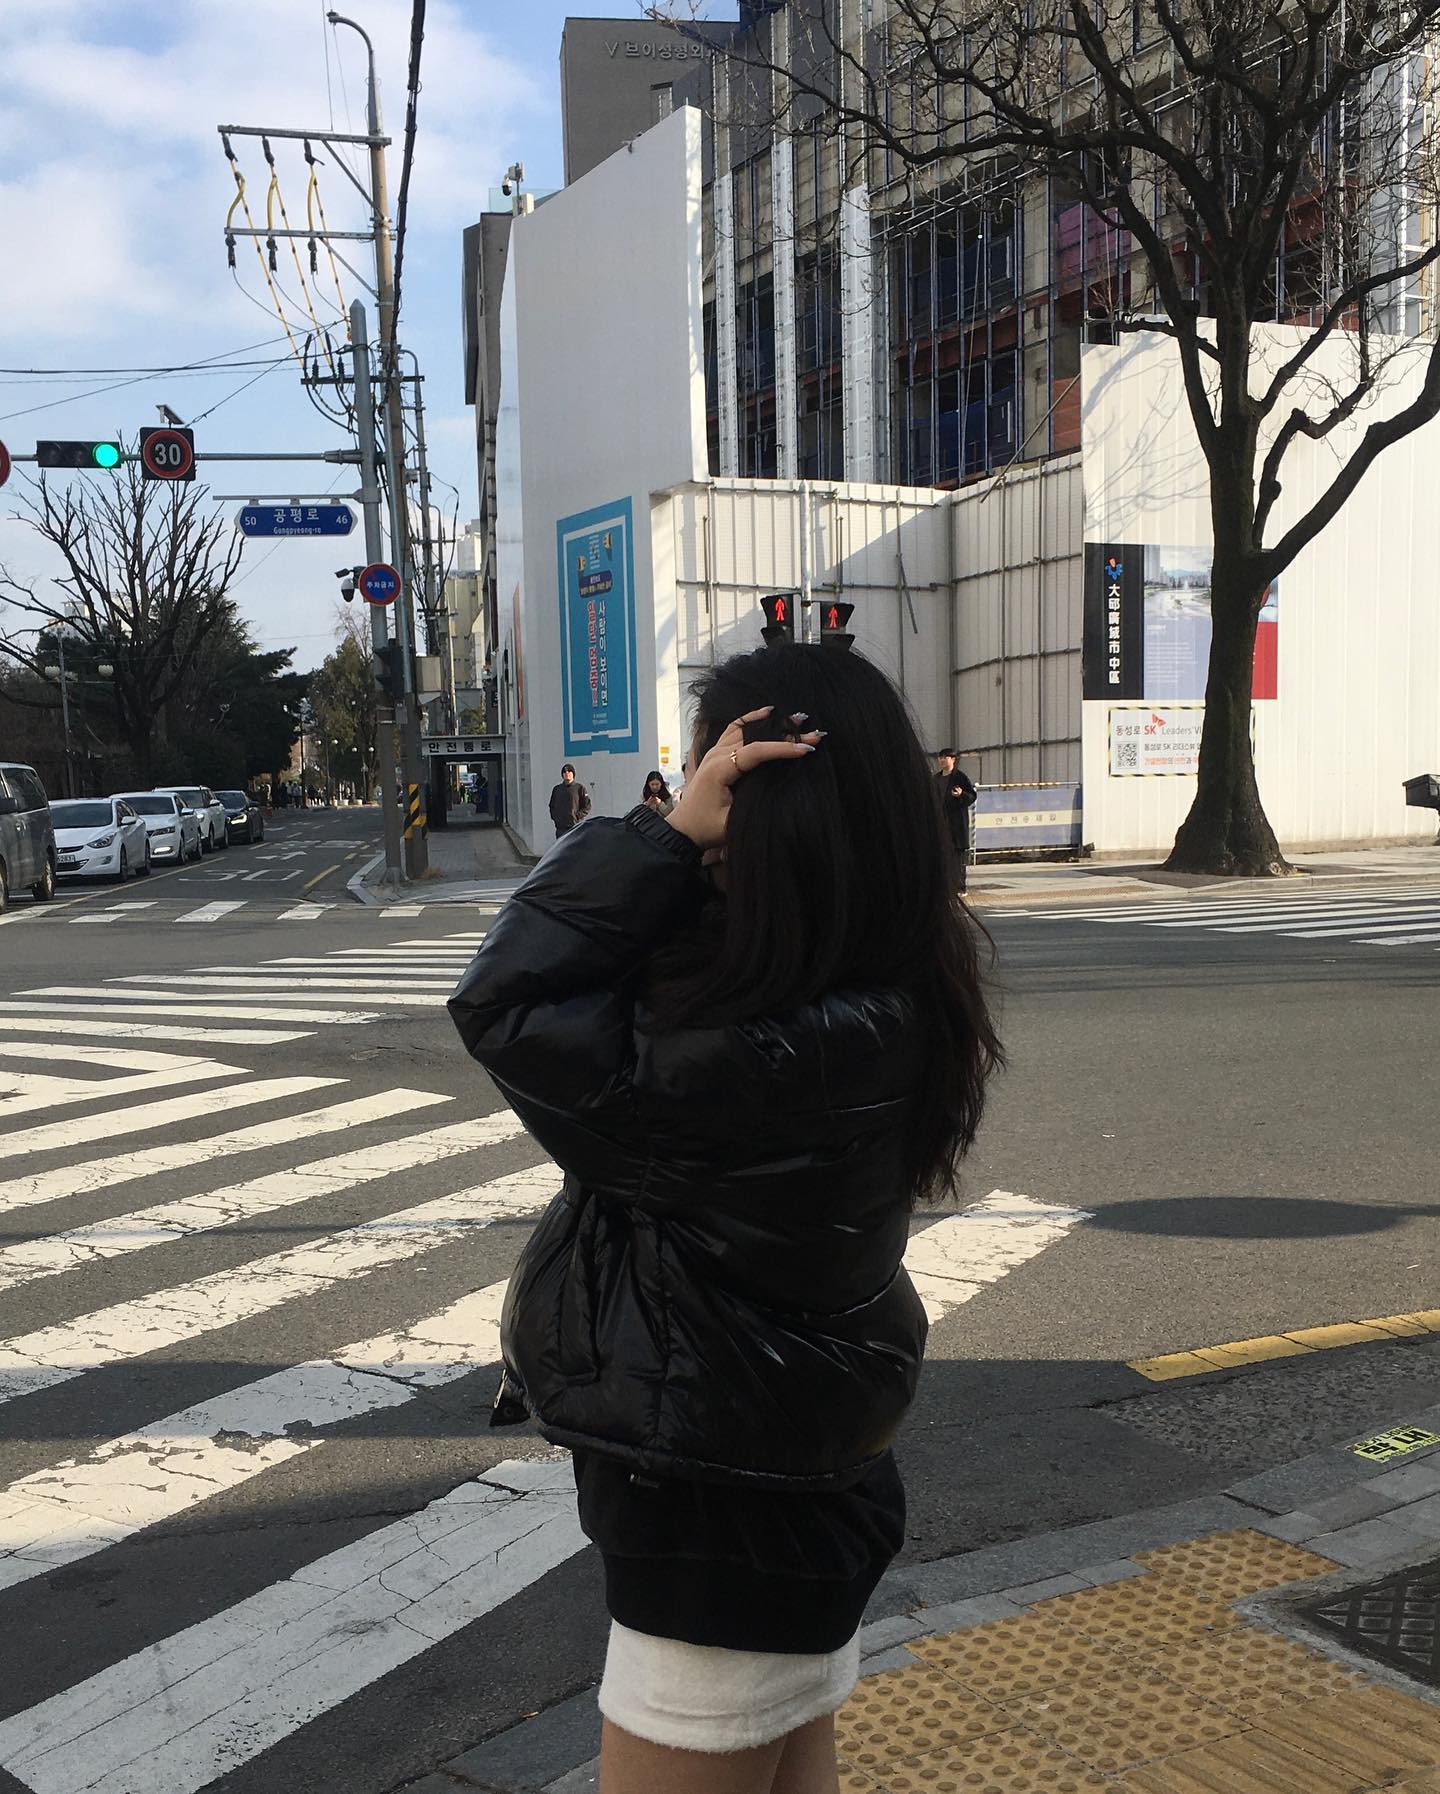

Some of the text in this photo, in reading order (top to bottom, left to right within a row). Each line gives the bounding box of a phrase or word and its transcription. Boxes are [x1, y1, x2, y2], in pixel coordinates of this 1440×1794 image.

[155, 443, 181, 465] 30
[245, 508, 348, 526] 50 공평로 46
[366, 581, 395, 589] 주차금지
[1116, 725, 1141, 736] 동성로
[1144, 725, 1157, 735] SK
[428, 741, 492, 753] 안전통로
